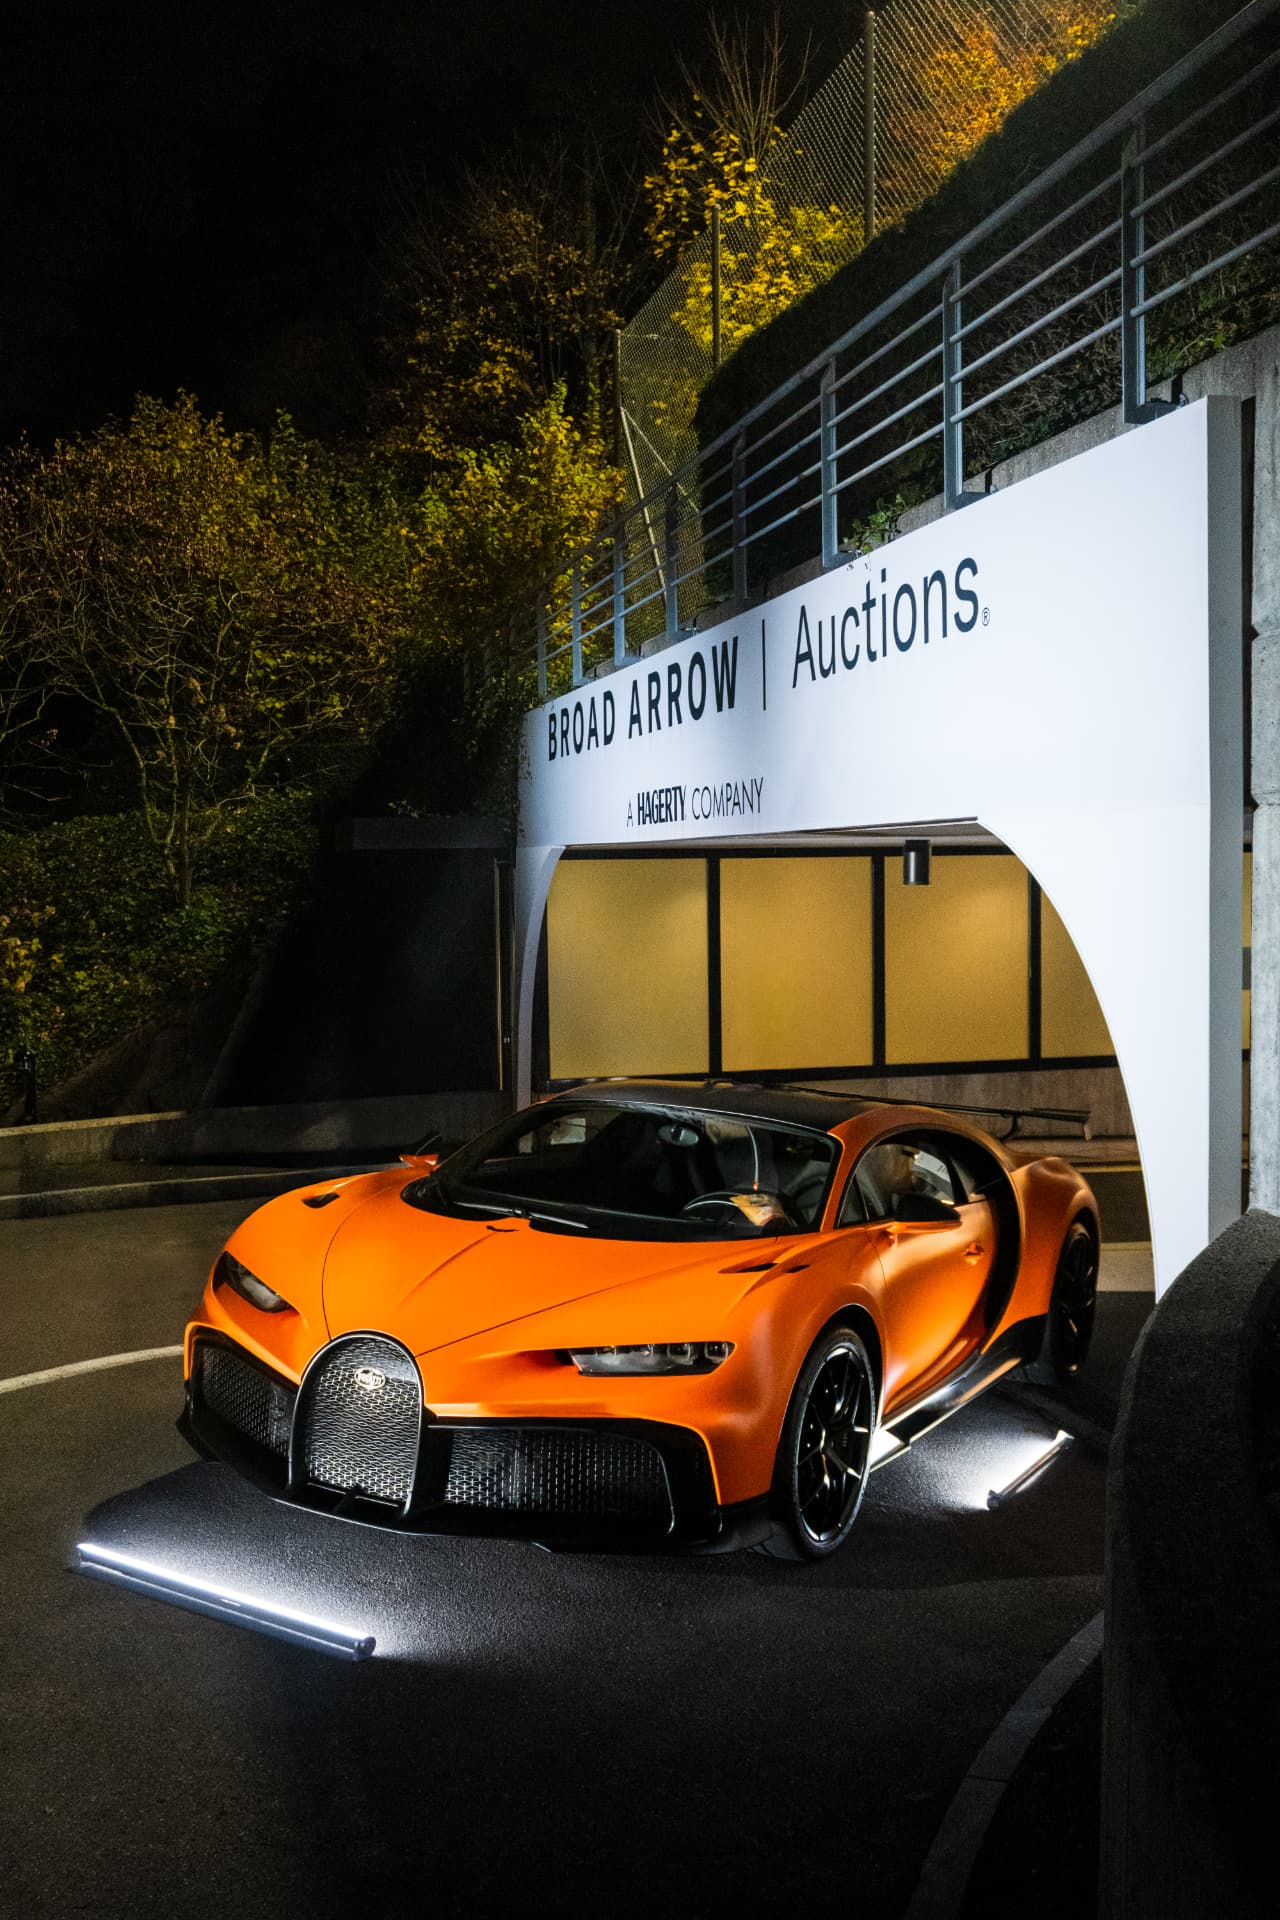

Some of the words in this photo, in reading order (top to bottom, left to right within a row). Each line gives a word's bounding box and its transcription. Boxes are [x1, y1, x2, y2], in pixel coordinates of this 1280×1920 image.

[549, 690, 615, 761] BROAD
[628, 636, 738, 739] ARROW
[627, 801, 634, 826] A
[637, 786, 686, 826] HAGERTY
[692, 777, 764, 819] COMPANY
